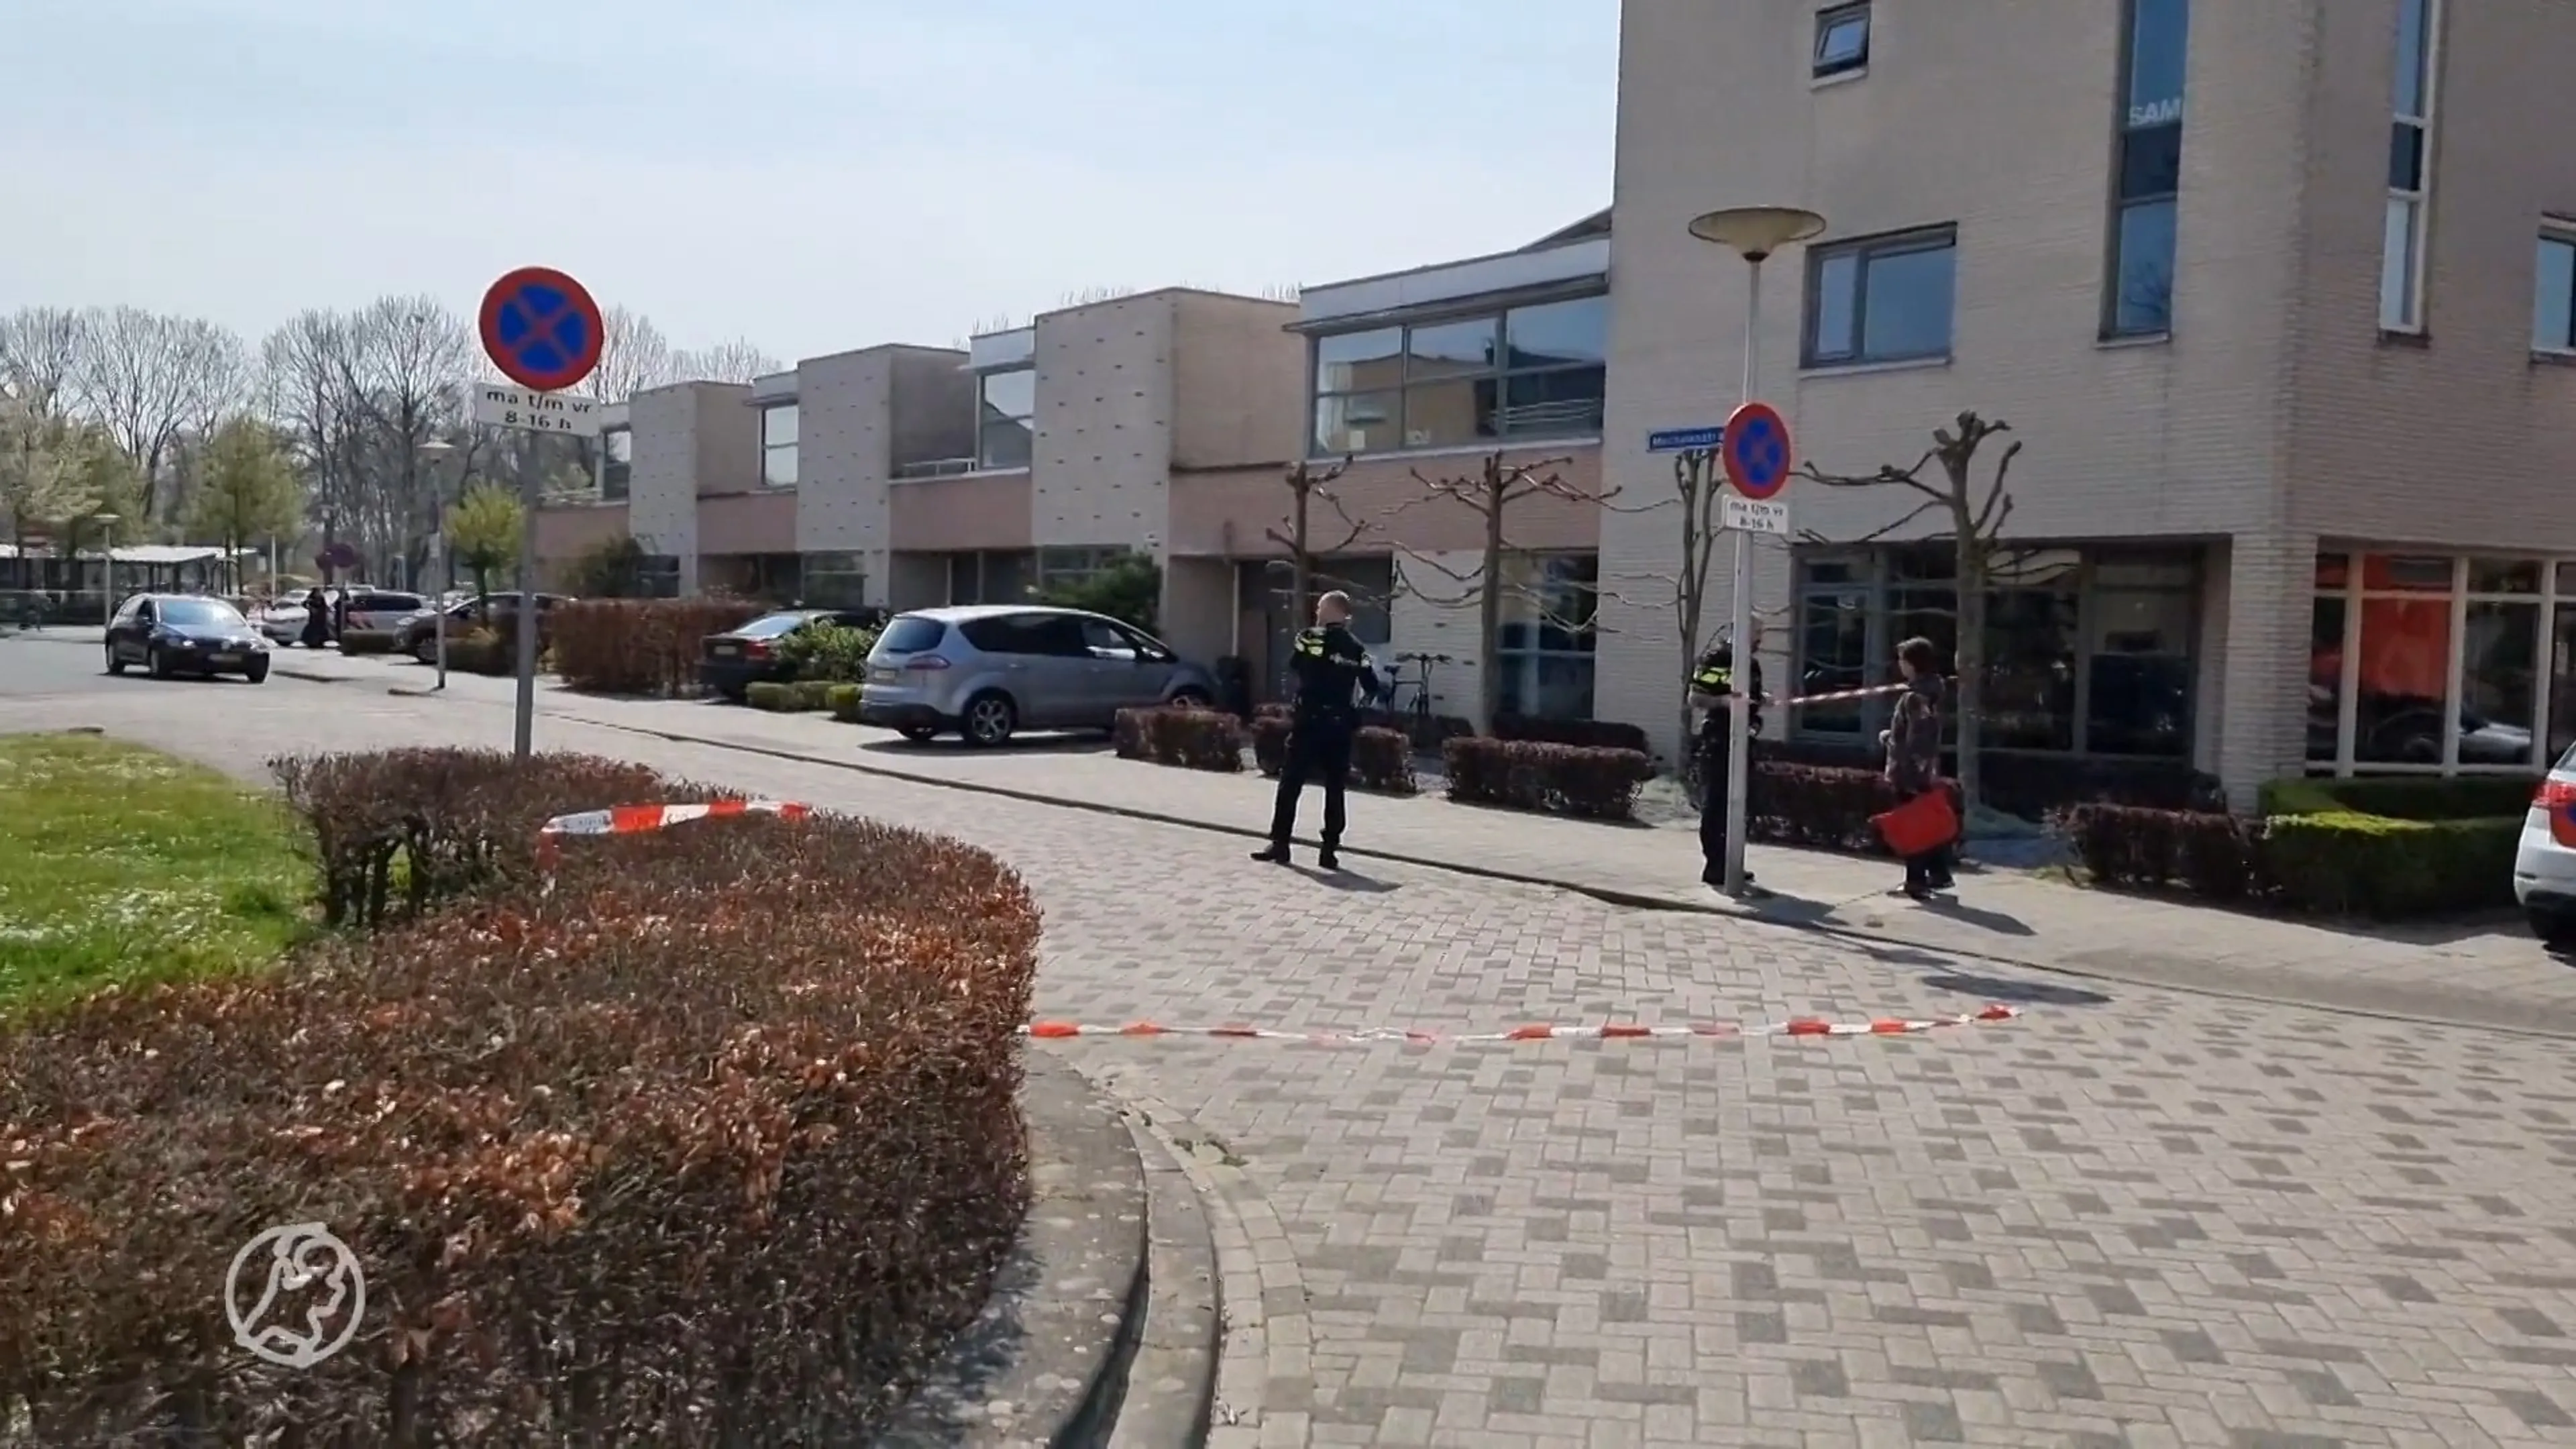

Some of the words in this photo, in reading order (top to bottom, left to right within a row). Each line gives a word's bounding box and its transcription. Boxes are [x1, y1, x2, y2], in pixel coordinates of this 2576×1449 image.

[486, 390, 518, 405] ma
[528, 394, 564, 411] t/m
[572, 401, 592, 413] vr
[559, 417, 572, 429] h
[1729, 501, 1747, 513] ma
